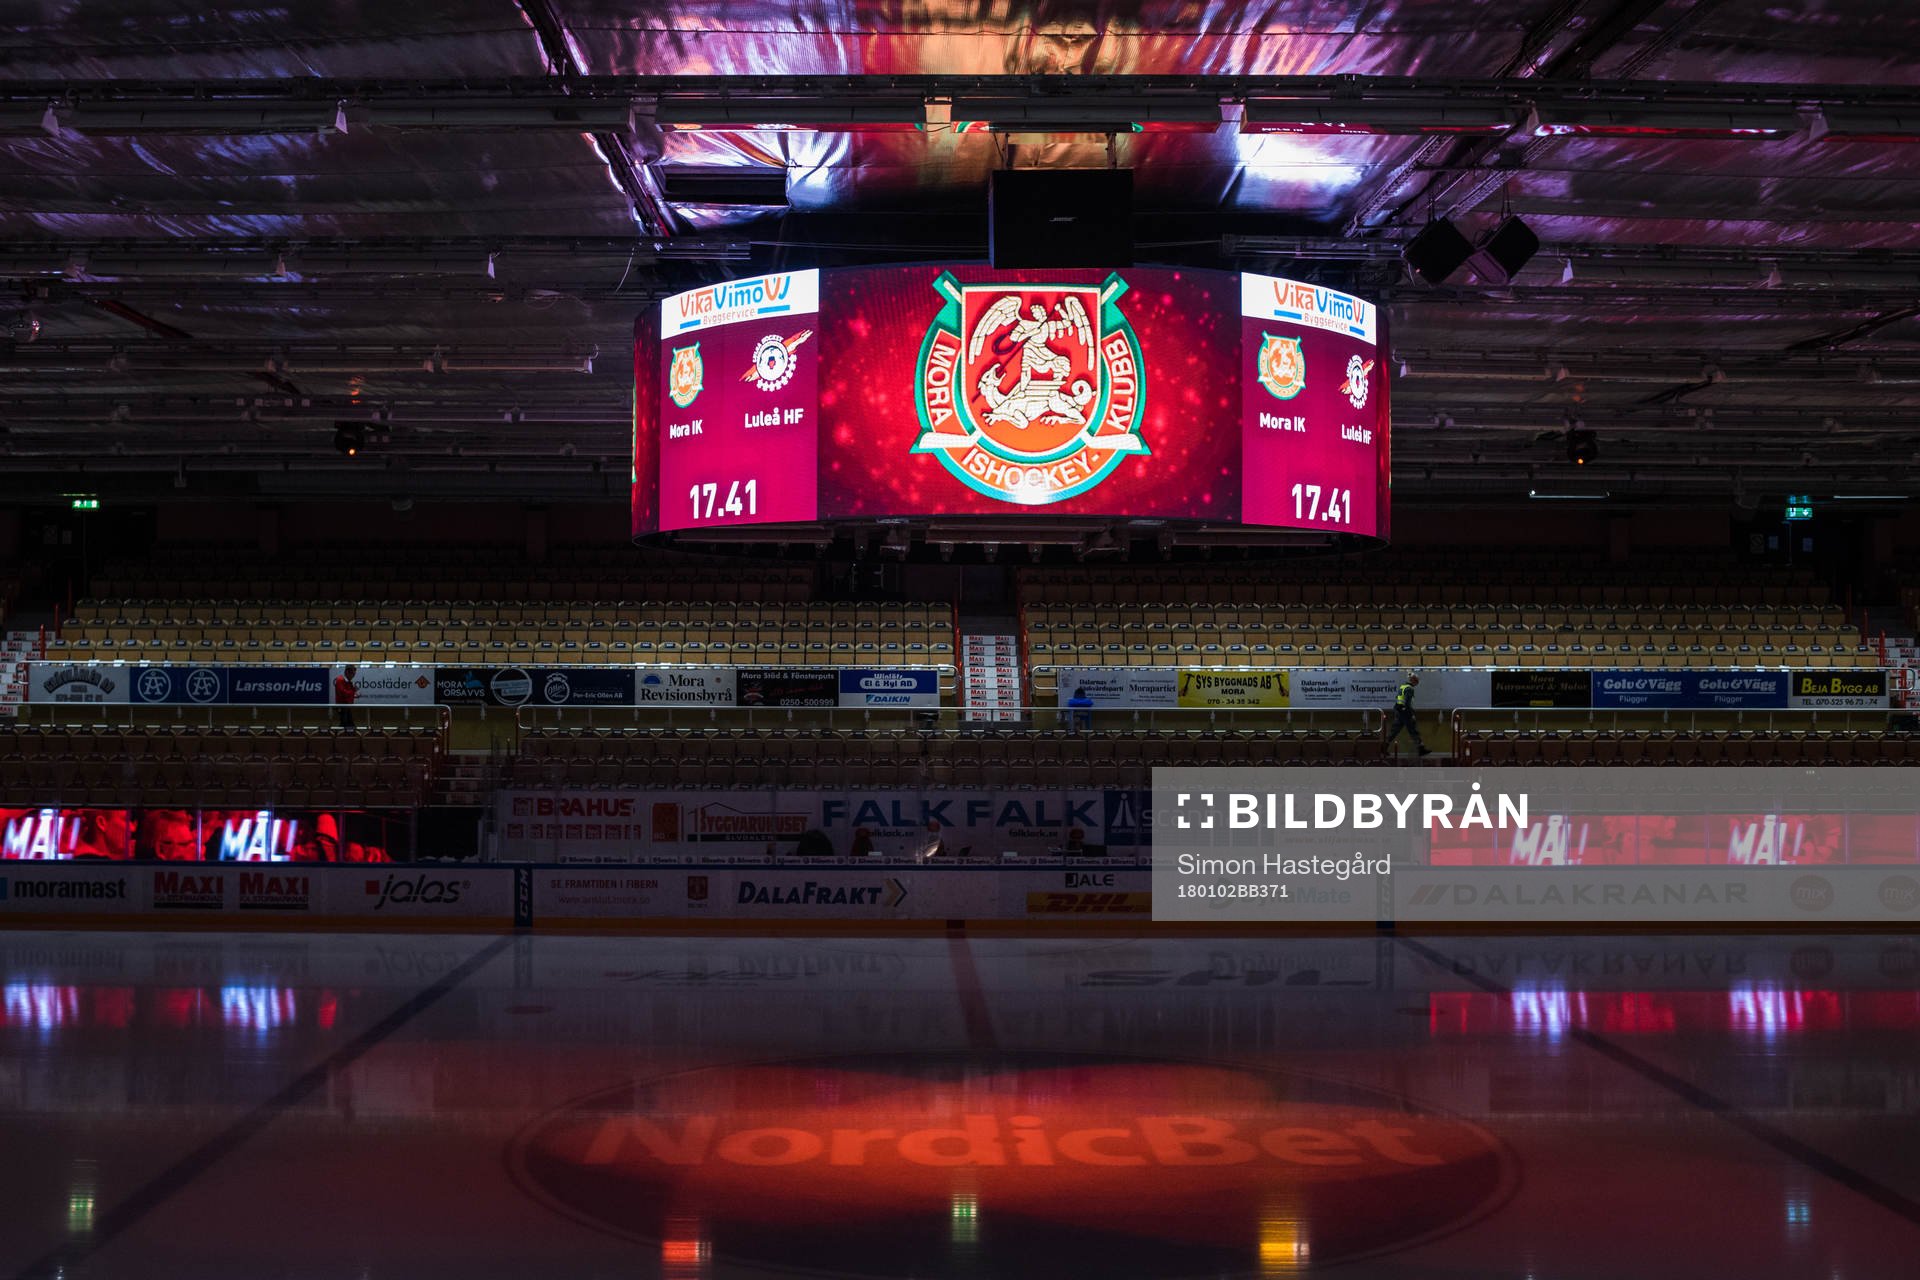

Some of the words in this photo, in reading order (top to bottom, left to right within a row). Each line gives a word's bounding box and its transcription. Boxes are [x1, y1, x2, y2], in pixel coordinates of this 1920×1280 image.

[926, 343, 956, 426] MORA
[1105, 338, 1134, 430] KLUBB
[744, 407, 780, 428] Luleå
[784, 408, 804, 424] HF
[1259, 412, 1291, 431] Mora
[1294, 417, 1306, 432] IK
[669, 426, 690, 439] Mora
[692, 420, 703, 434] IK
[1341, 424, 1362, 442] Luleå
[1362, 430, 1372, 445] HF
[690, 480, 757, 519] 17.41
[1292, 483, 1351, 524] 17.41
[235, 679, 323, 693] Larsson-Hus
[437, 680, 463, 689] MORA
[669, 675, 704, 687] Mora
[1129, 684, 1176, 693] Morapartiet
[1196, 675, 1212, 689] SYS
[1214, 676, 1258, 687] BYGGNADS
[1260, 675, 1272, 689] AB
[1351, 685, 1397, 693] Morapartiet
[1801, 678, 1828, 694] BEJA
[1830, 678, 1864, 694] BYGG
[1865, 684, 1879, 694] AB
[641, 688, 732, 704] Revisionsbyrå
[537, 798, 635, 816] BRAHUS
[823, 800, 955, 827] FALK
[966, 800, 1098, 827] FALK
[2, 808, 81, 859] MÅL!
[219, 810, 298, 862] MÅL!
[1510, 814, 1588, 865] MÅL!
[1727, 814, 1804, 865] MÅL!
[14, 878, 126, 898] moramast
[154, 872, 224, 894] MAXI
[240, 873, 309, 895] MAXI
[374, 874, 460, 910] jalas
[551, 880, 562, 889] SE
[565, 880, 617, 889] FRAMTIDEN
[627, 880, 658, 889] FIBERN
[1047, 894, 1128, 904] DHL
[1453, 884, 1748, 905] DALAKRANAR
[582, 1112, 1446, 1166] NordicBet
